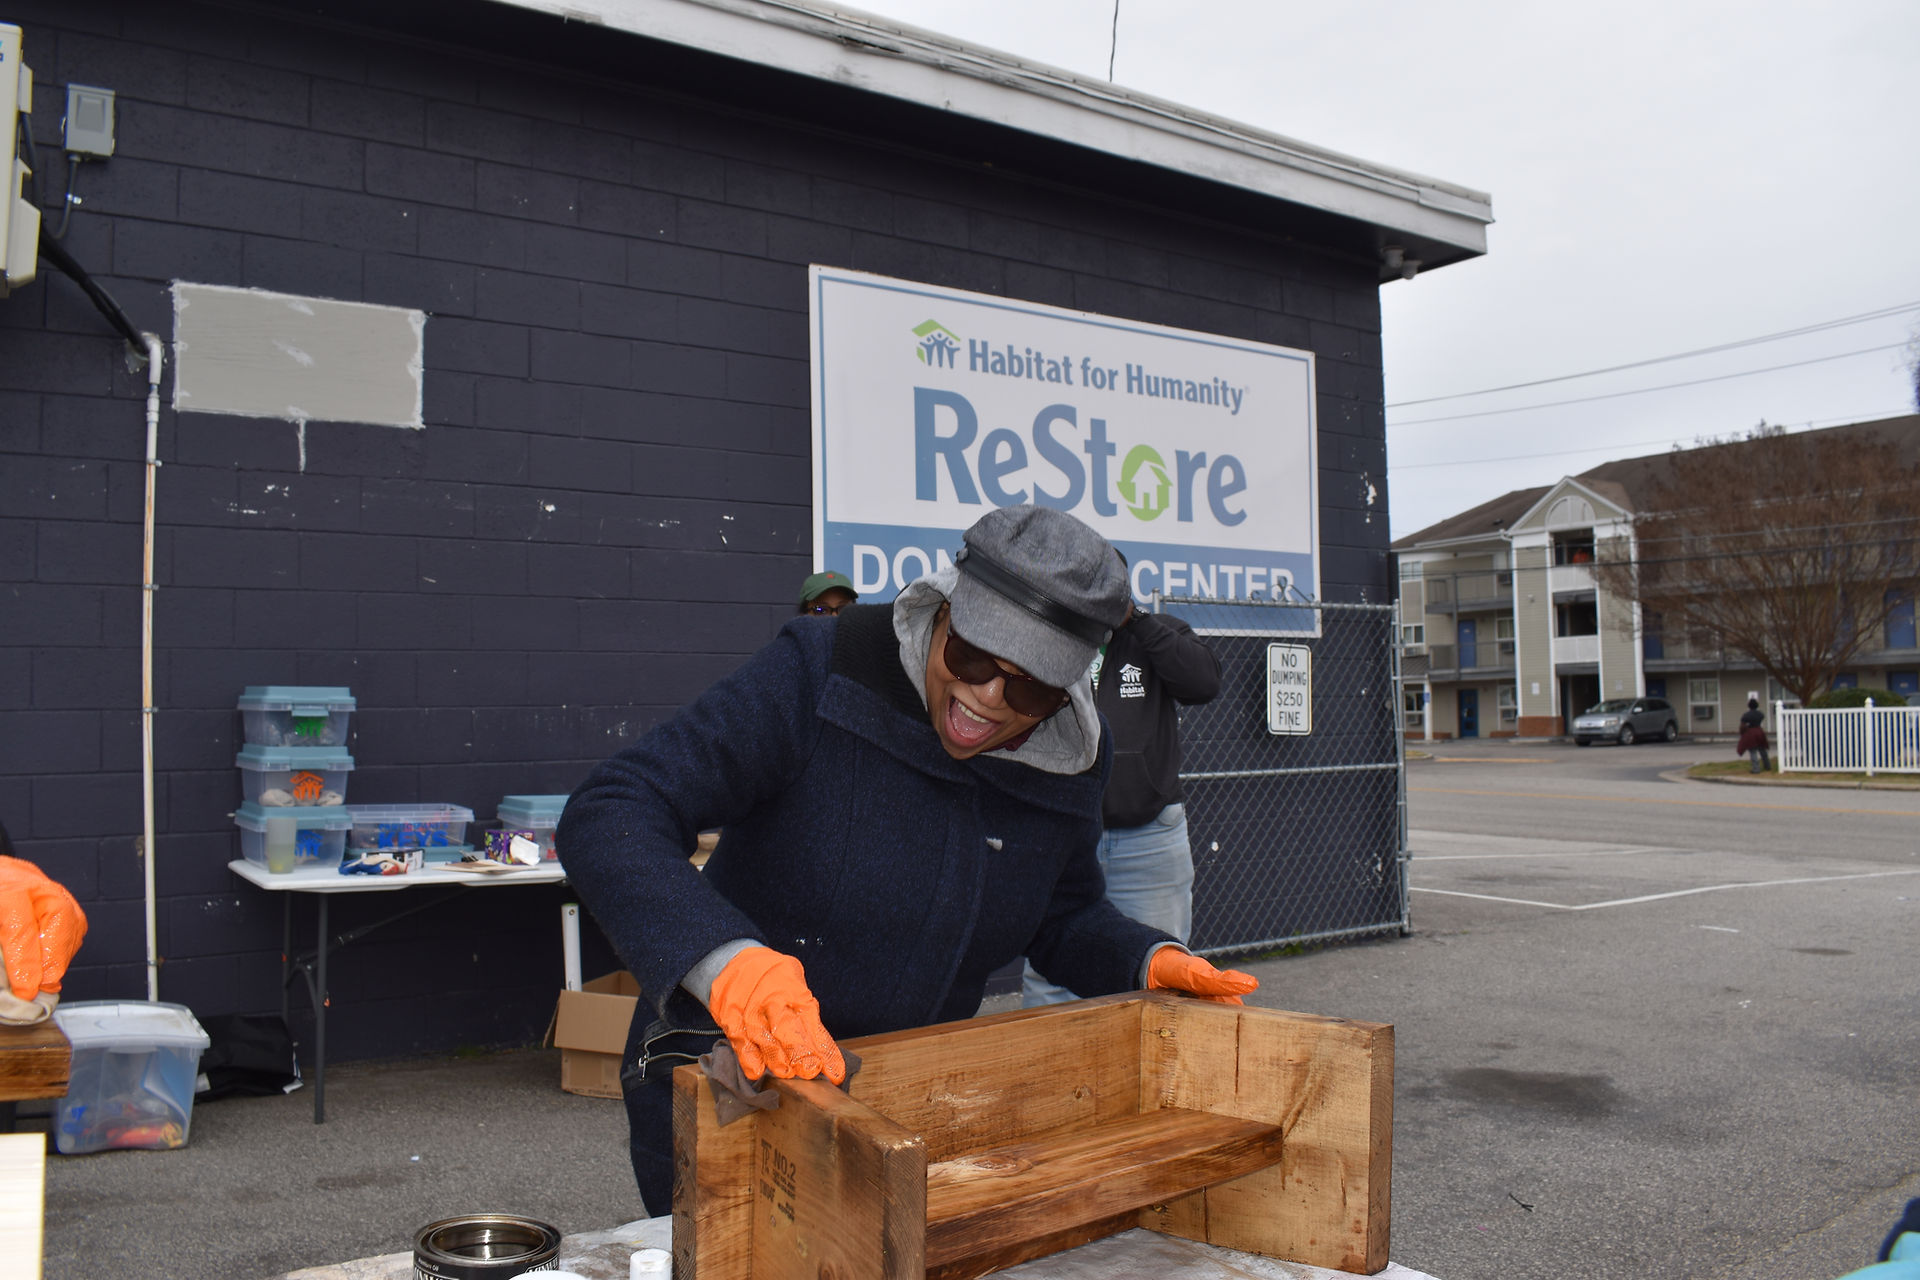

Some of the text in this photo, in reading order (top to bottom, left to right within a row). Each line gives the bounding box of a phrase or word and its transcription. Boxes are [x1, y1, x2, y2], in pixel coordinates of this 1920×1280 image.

[969, 338, 1243, 415] Habitat for Humanity
[914, 387, 1247, 527] ReStore
[1131, 560, 1294, 604] CENTER
[1281, 653, 1298, 668] NO
[1272, 670, 1307, 686] DUMPING
[1276, 690, 1303, 707] $250
[1279, 711, 1301, 726] FINE
[378, 831, 449, 848] KEYS
[774, 1148, 796, 1183] NO.2
